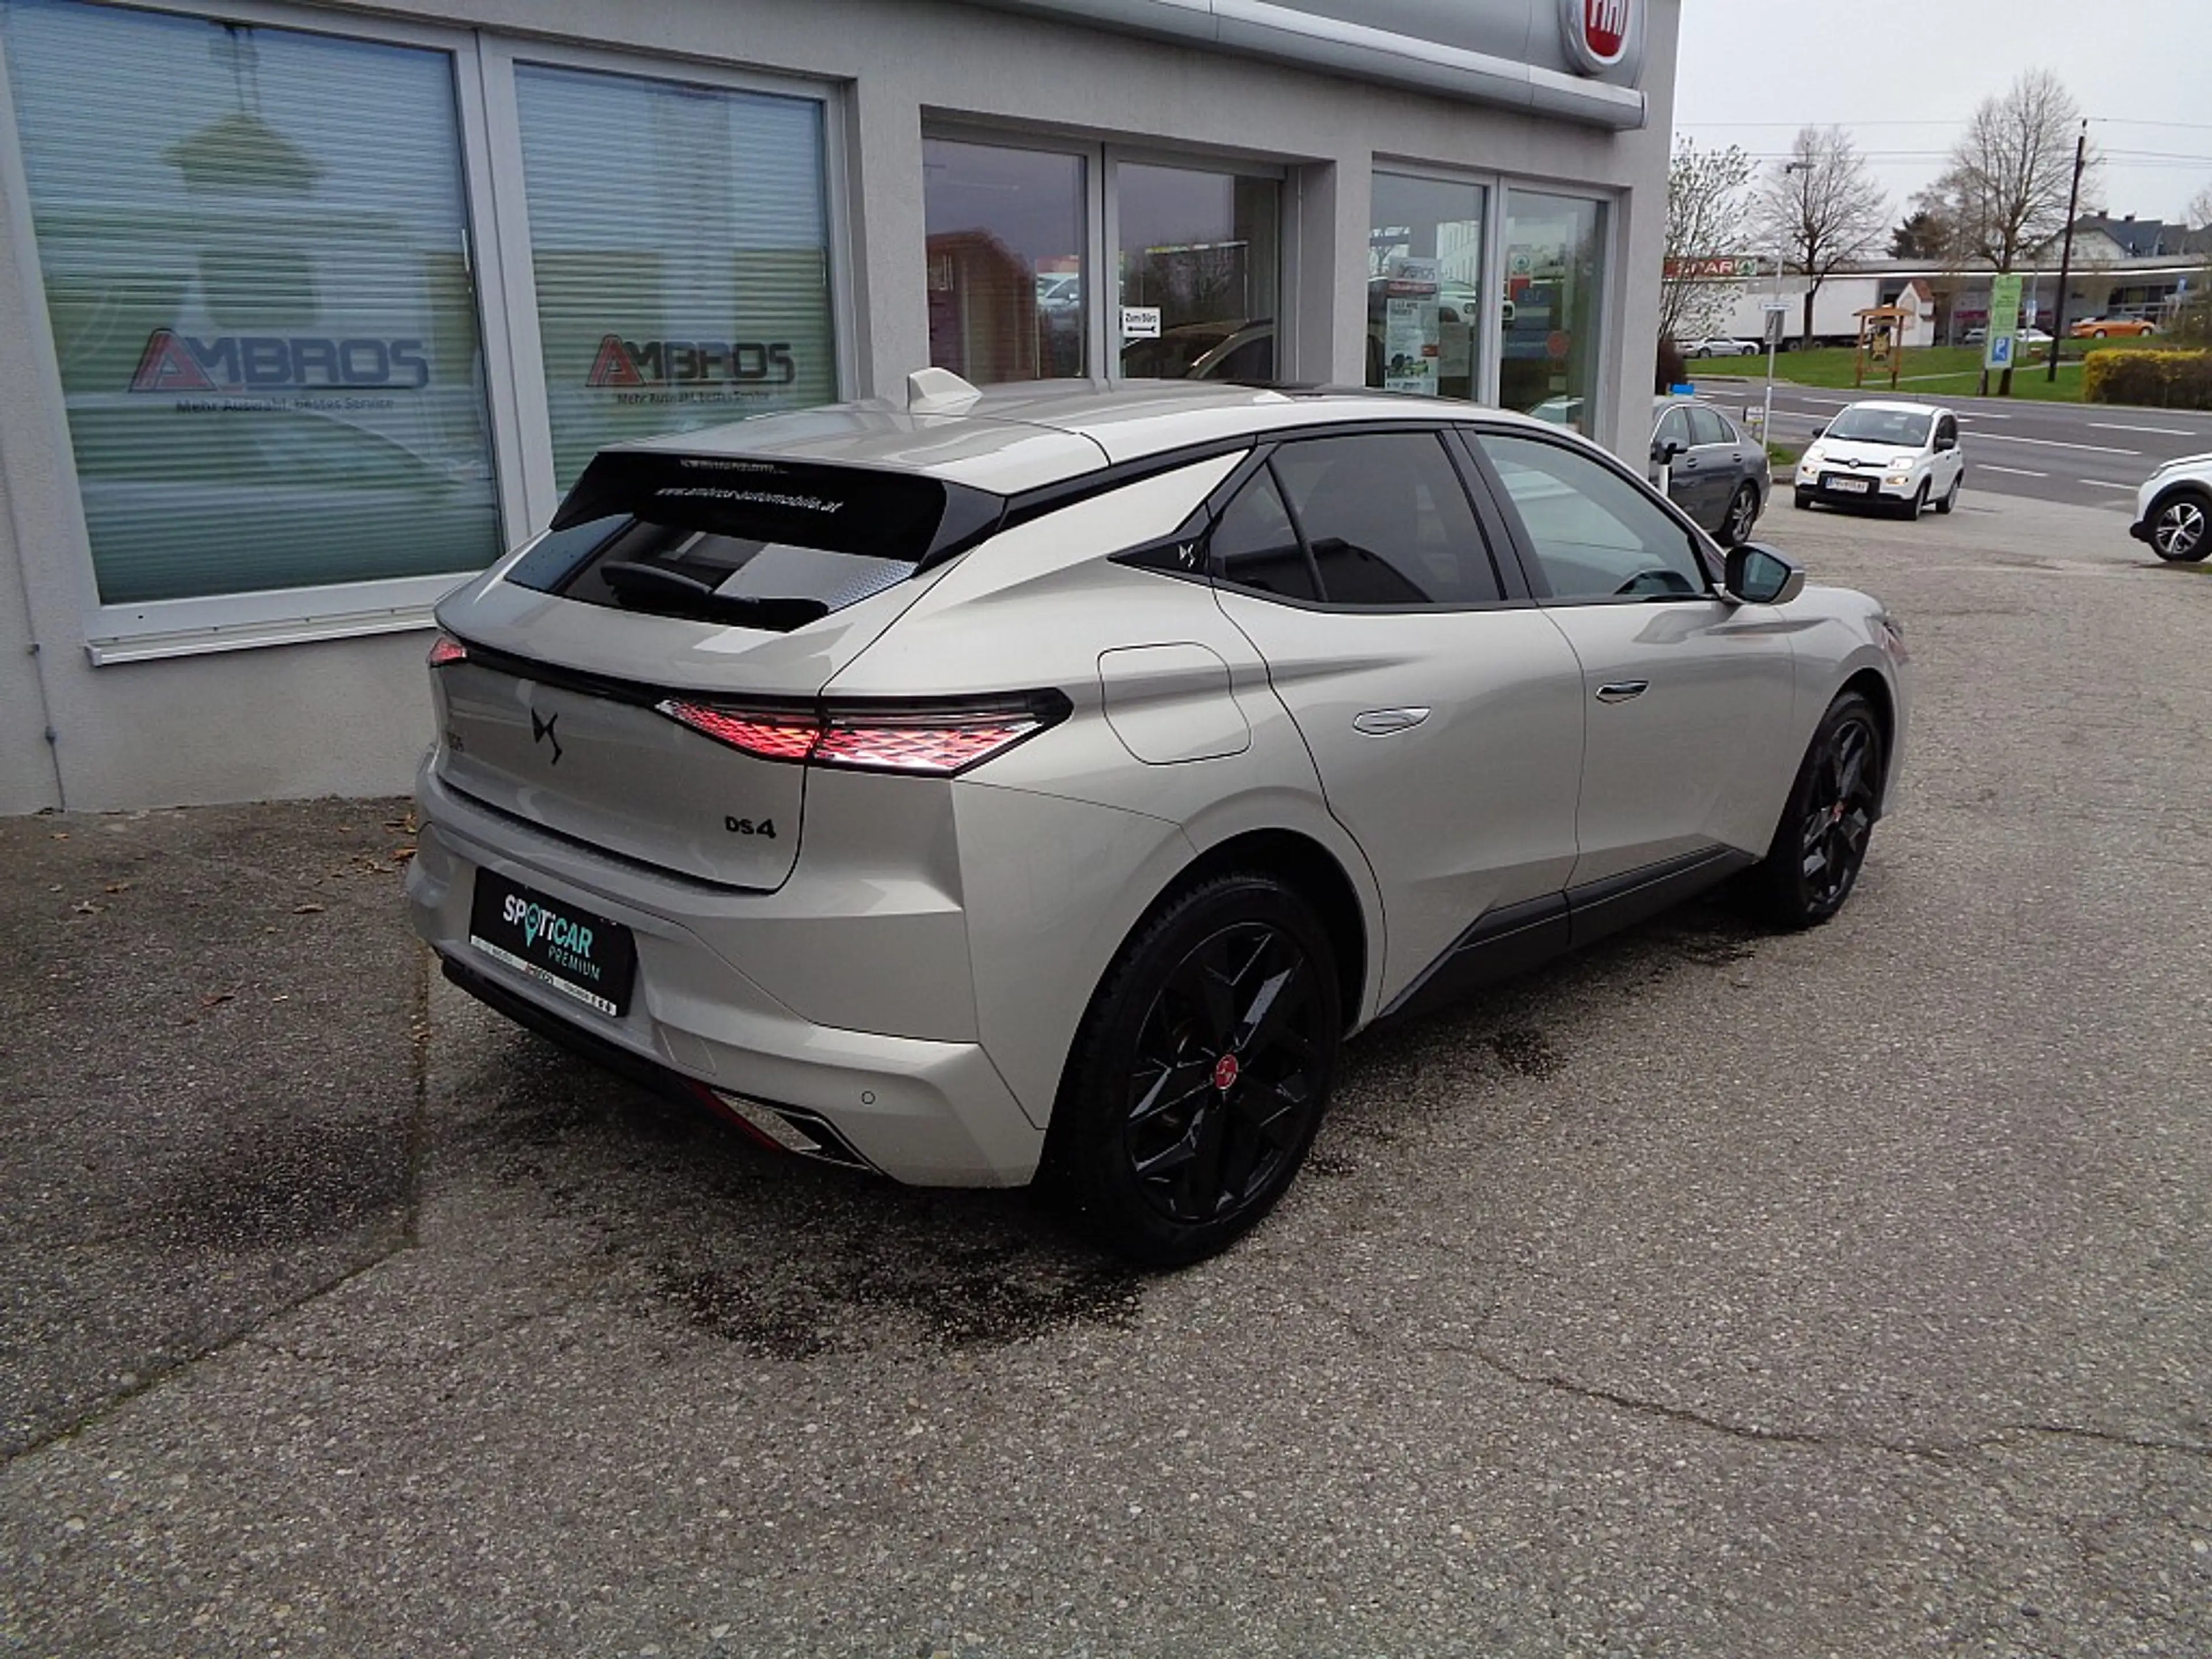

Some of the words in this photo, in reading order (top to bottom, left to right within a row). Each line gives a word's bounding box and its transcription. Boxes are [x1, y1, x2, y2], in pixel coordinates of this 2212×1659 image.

[1126, 313, 1141, 323] Zum
[128, 328, 429, 392] AMBROS
[585, 334, 796, 387] AMBROS
[548, 945, 601, 982] PREMIUM
